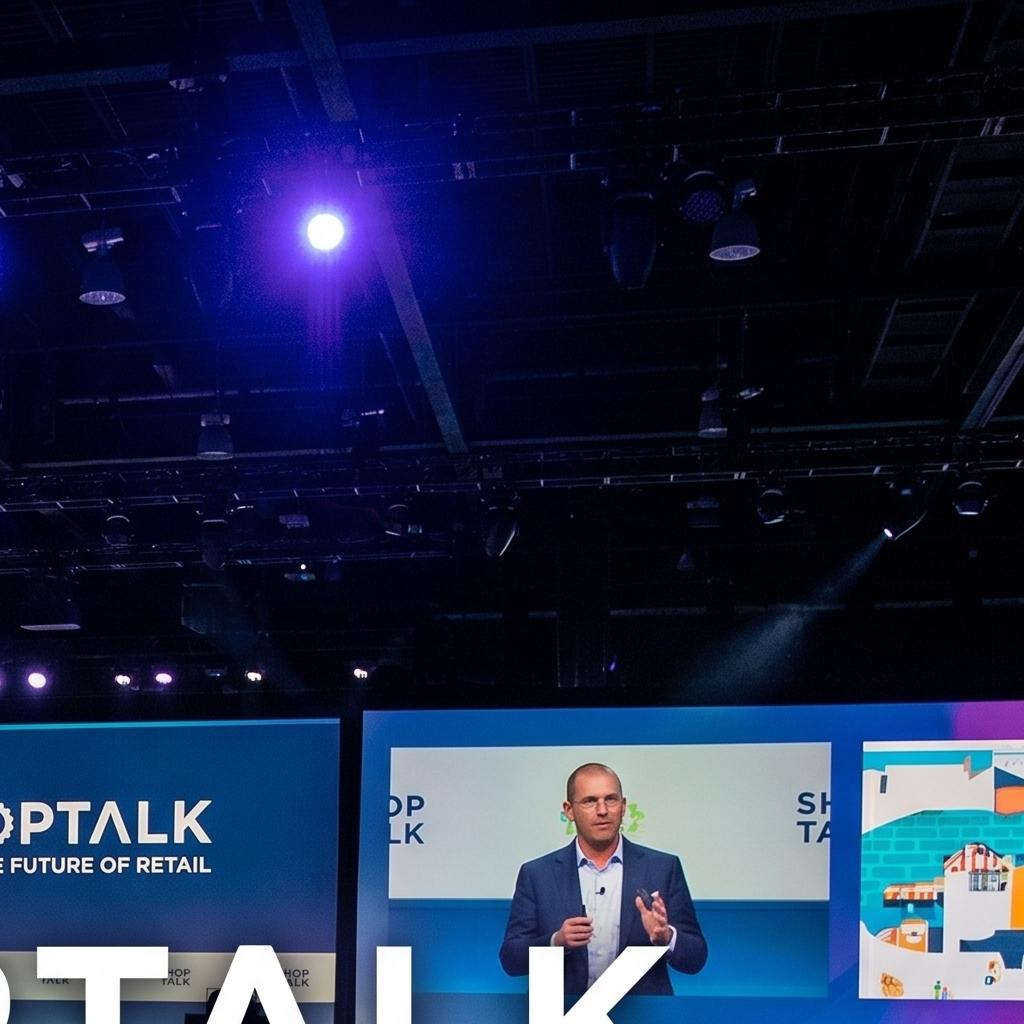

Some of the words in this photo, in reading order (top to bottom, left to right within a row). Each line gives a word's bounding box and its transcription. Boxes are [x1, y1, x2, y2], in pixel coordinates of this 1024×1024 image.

[10, 857, 94, 874] FUTURE
[100, 857, 131, 873] OF
[136, 856, 212, 873] RETAIL
